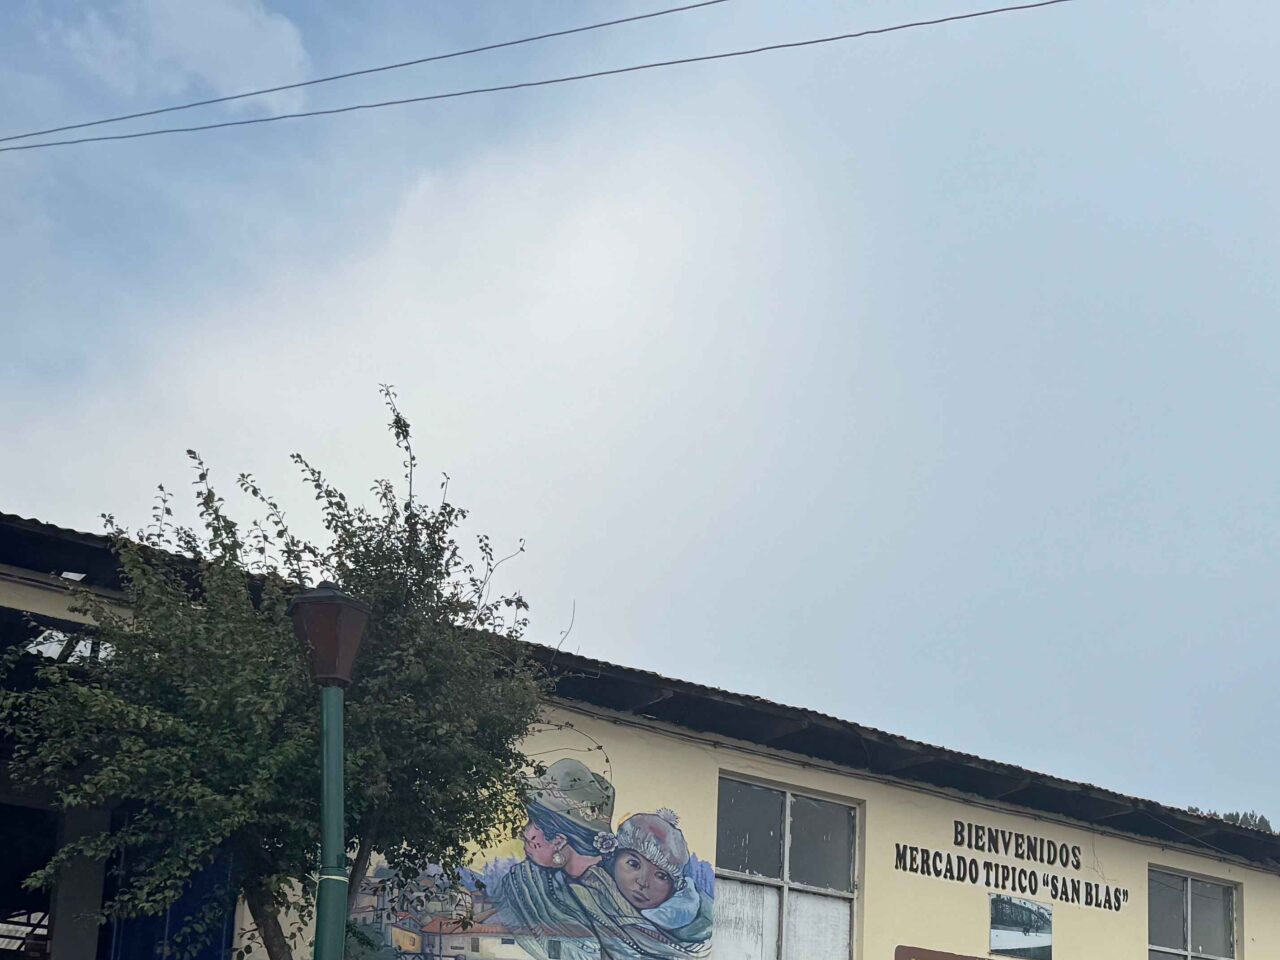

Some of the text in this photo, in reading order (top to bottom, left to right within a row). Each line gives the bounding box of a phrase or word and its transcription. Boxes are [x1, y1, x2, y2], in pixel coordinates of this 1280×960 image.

[895, 843, 979, 884] MERCADO
[983, 861, 1038, 895] TIPICO
[954, 820, 1081, 870] BIENVENIDOS
